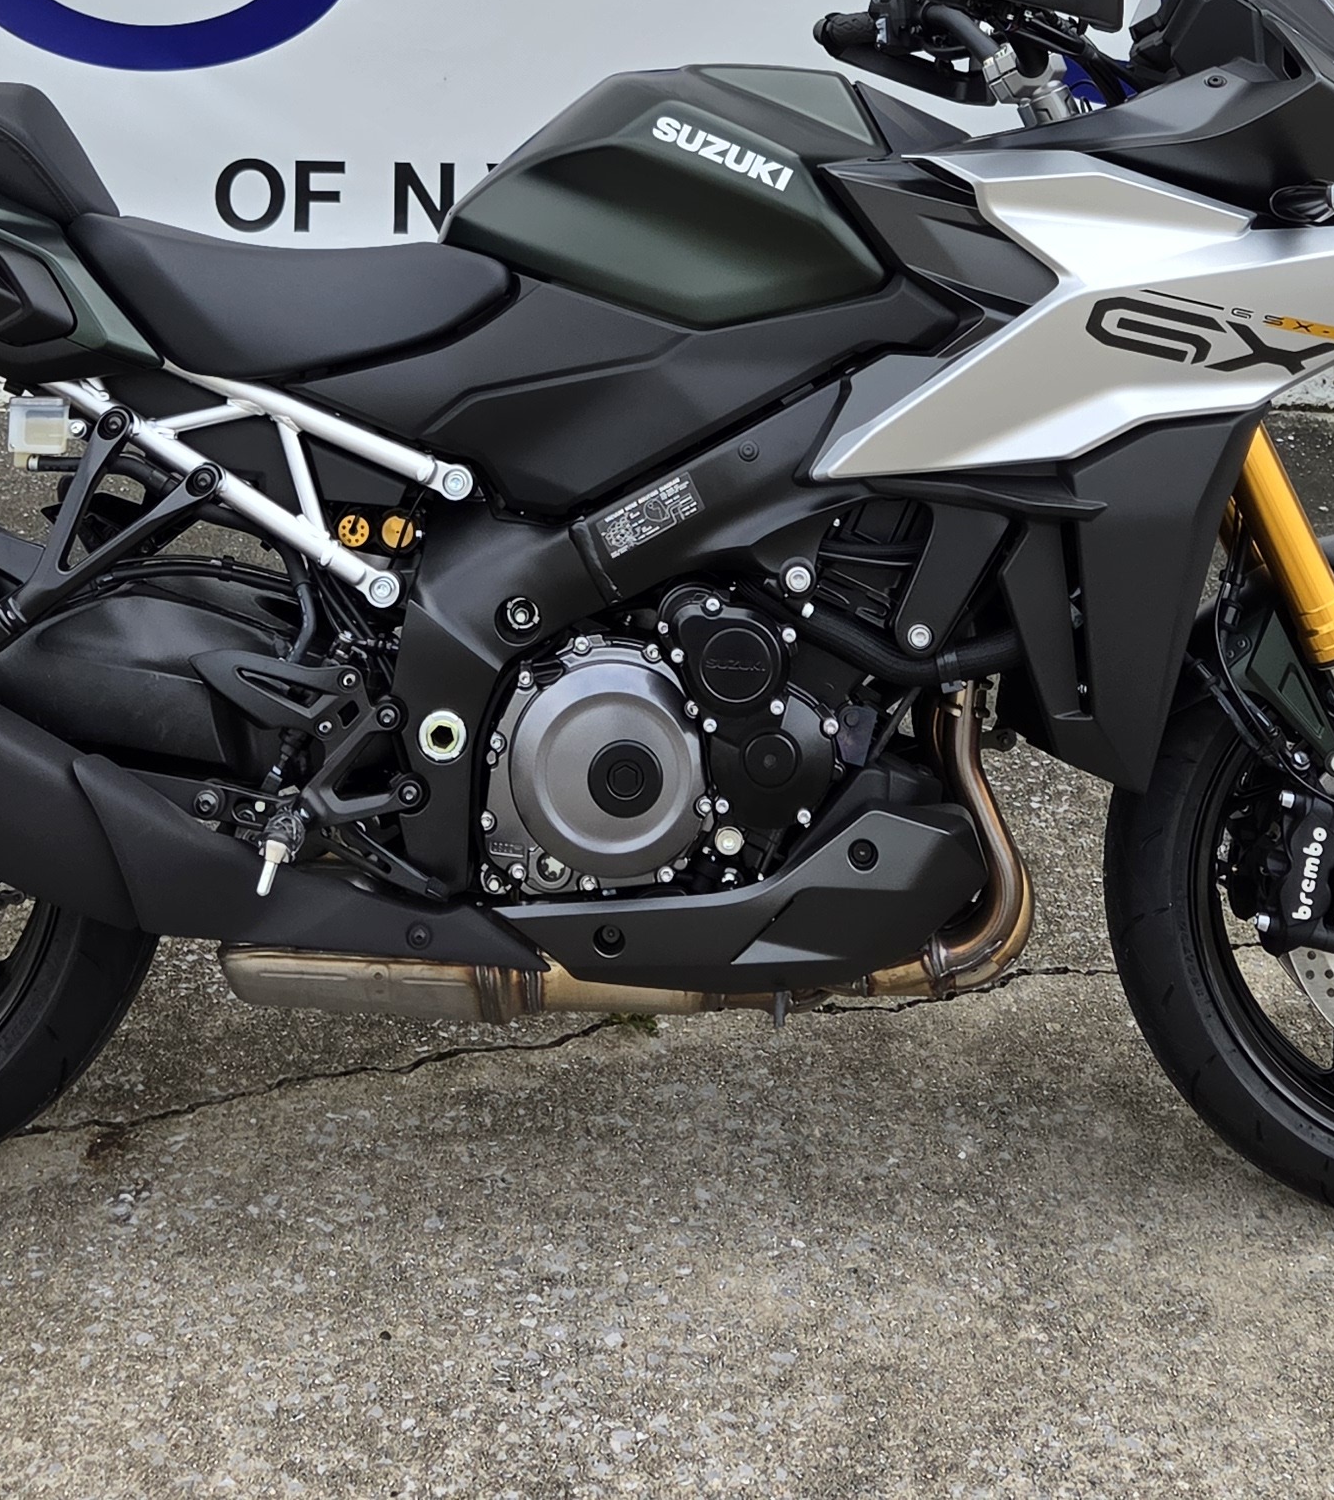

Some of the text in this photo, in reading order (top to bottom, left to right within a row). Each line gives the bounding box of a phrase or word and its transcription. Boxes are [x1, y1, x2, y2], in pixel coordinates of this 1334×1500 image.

[652, 116, 794, 191] SUZUKI
[215, 158, 346, 233] OF
[1291, 826, 1327, 920] brembo
